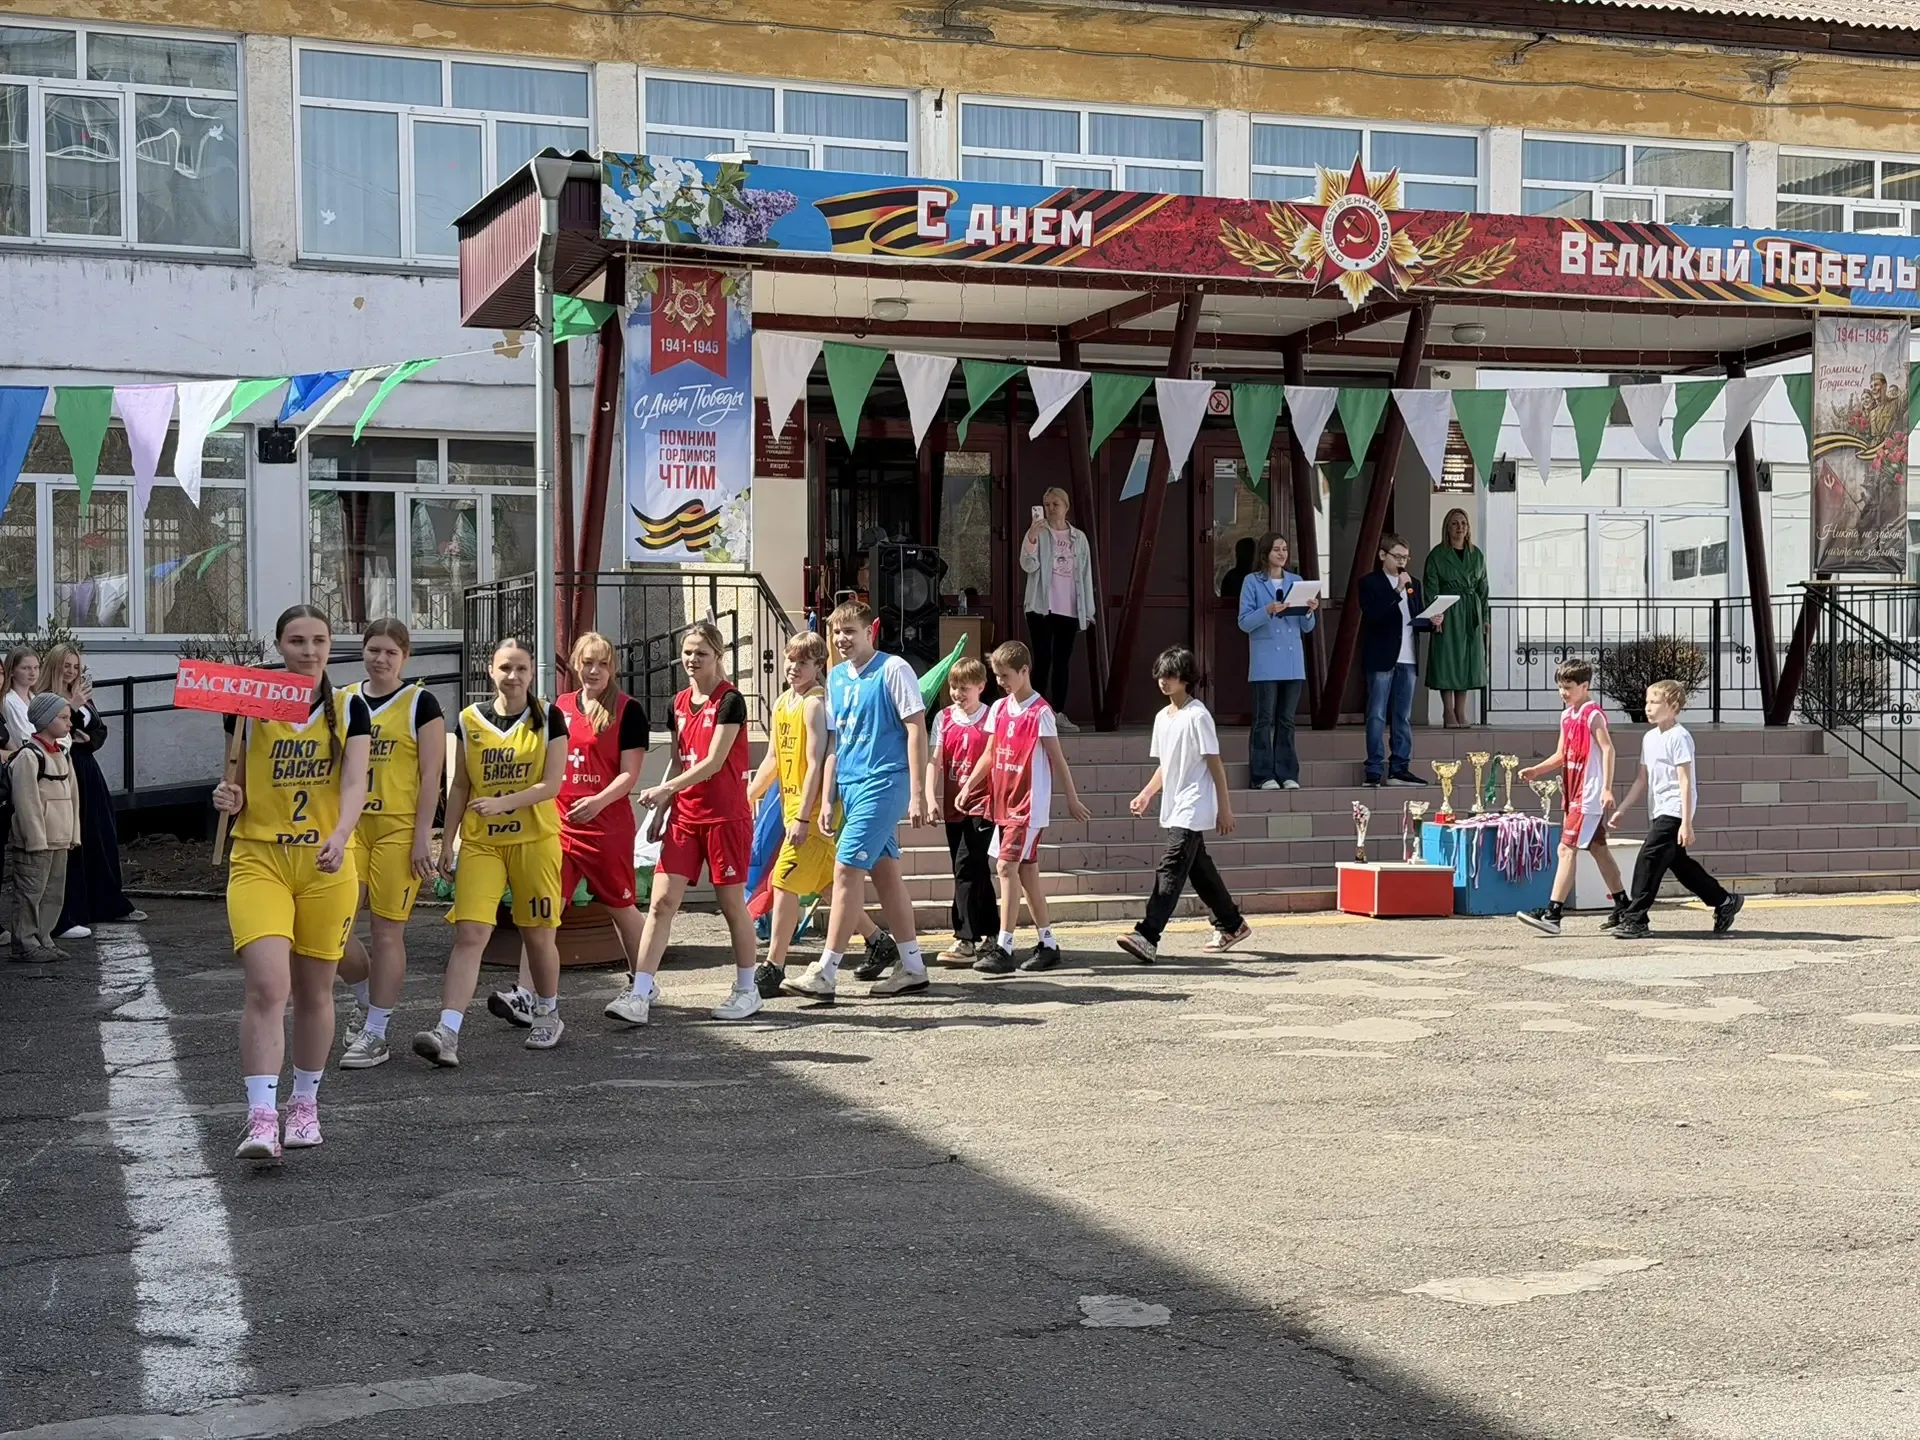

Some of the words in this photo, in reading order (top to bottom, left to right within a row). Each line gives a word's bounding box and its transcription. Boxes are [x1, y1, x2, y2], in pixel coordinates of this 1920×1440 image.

[917, 190, 949, 239] С
[965, 202, 1095, 248] ДНЕМ
[1560, 230, 1750, 284] ВЕЛИКОЙ
[660, 338, 719, 354] 1941-1945
[677, 383, 745, 427] Победы
[659, 429, 717, 447] ПОМНИМ
[659, 448, 717, 463] ГОРДИМСЯ
[659, 464, 717, 490] ЧТИМ
[1816, 523, 1859, 540] Никто
[176, 667, 313, 704] БАСКЕТБОЛ
[1007, 721, 1016, 738] 8
[269, 739, 320, 759] ЛОКО
[962, 733, 969, 750] 1
[481, 747, 515, 765] ЛОКО
[483, 761, 533, 782] БАСКЕТ
[572, 773, 601, 784] group
[785, 759, 792, 780] 7
[292, 790, 308, 822] 2
[782, 861, 797, 879] 7
[403, 886, 411, 911] 1
[528, 897, 551, 919] 10
